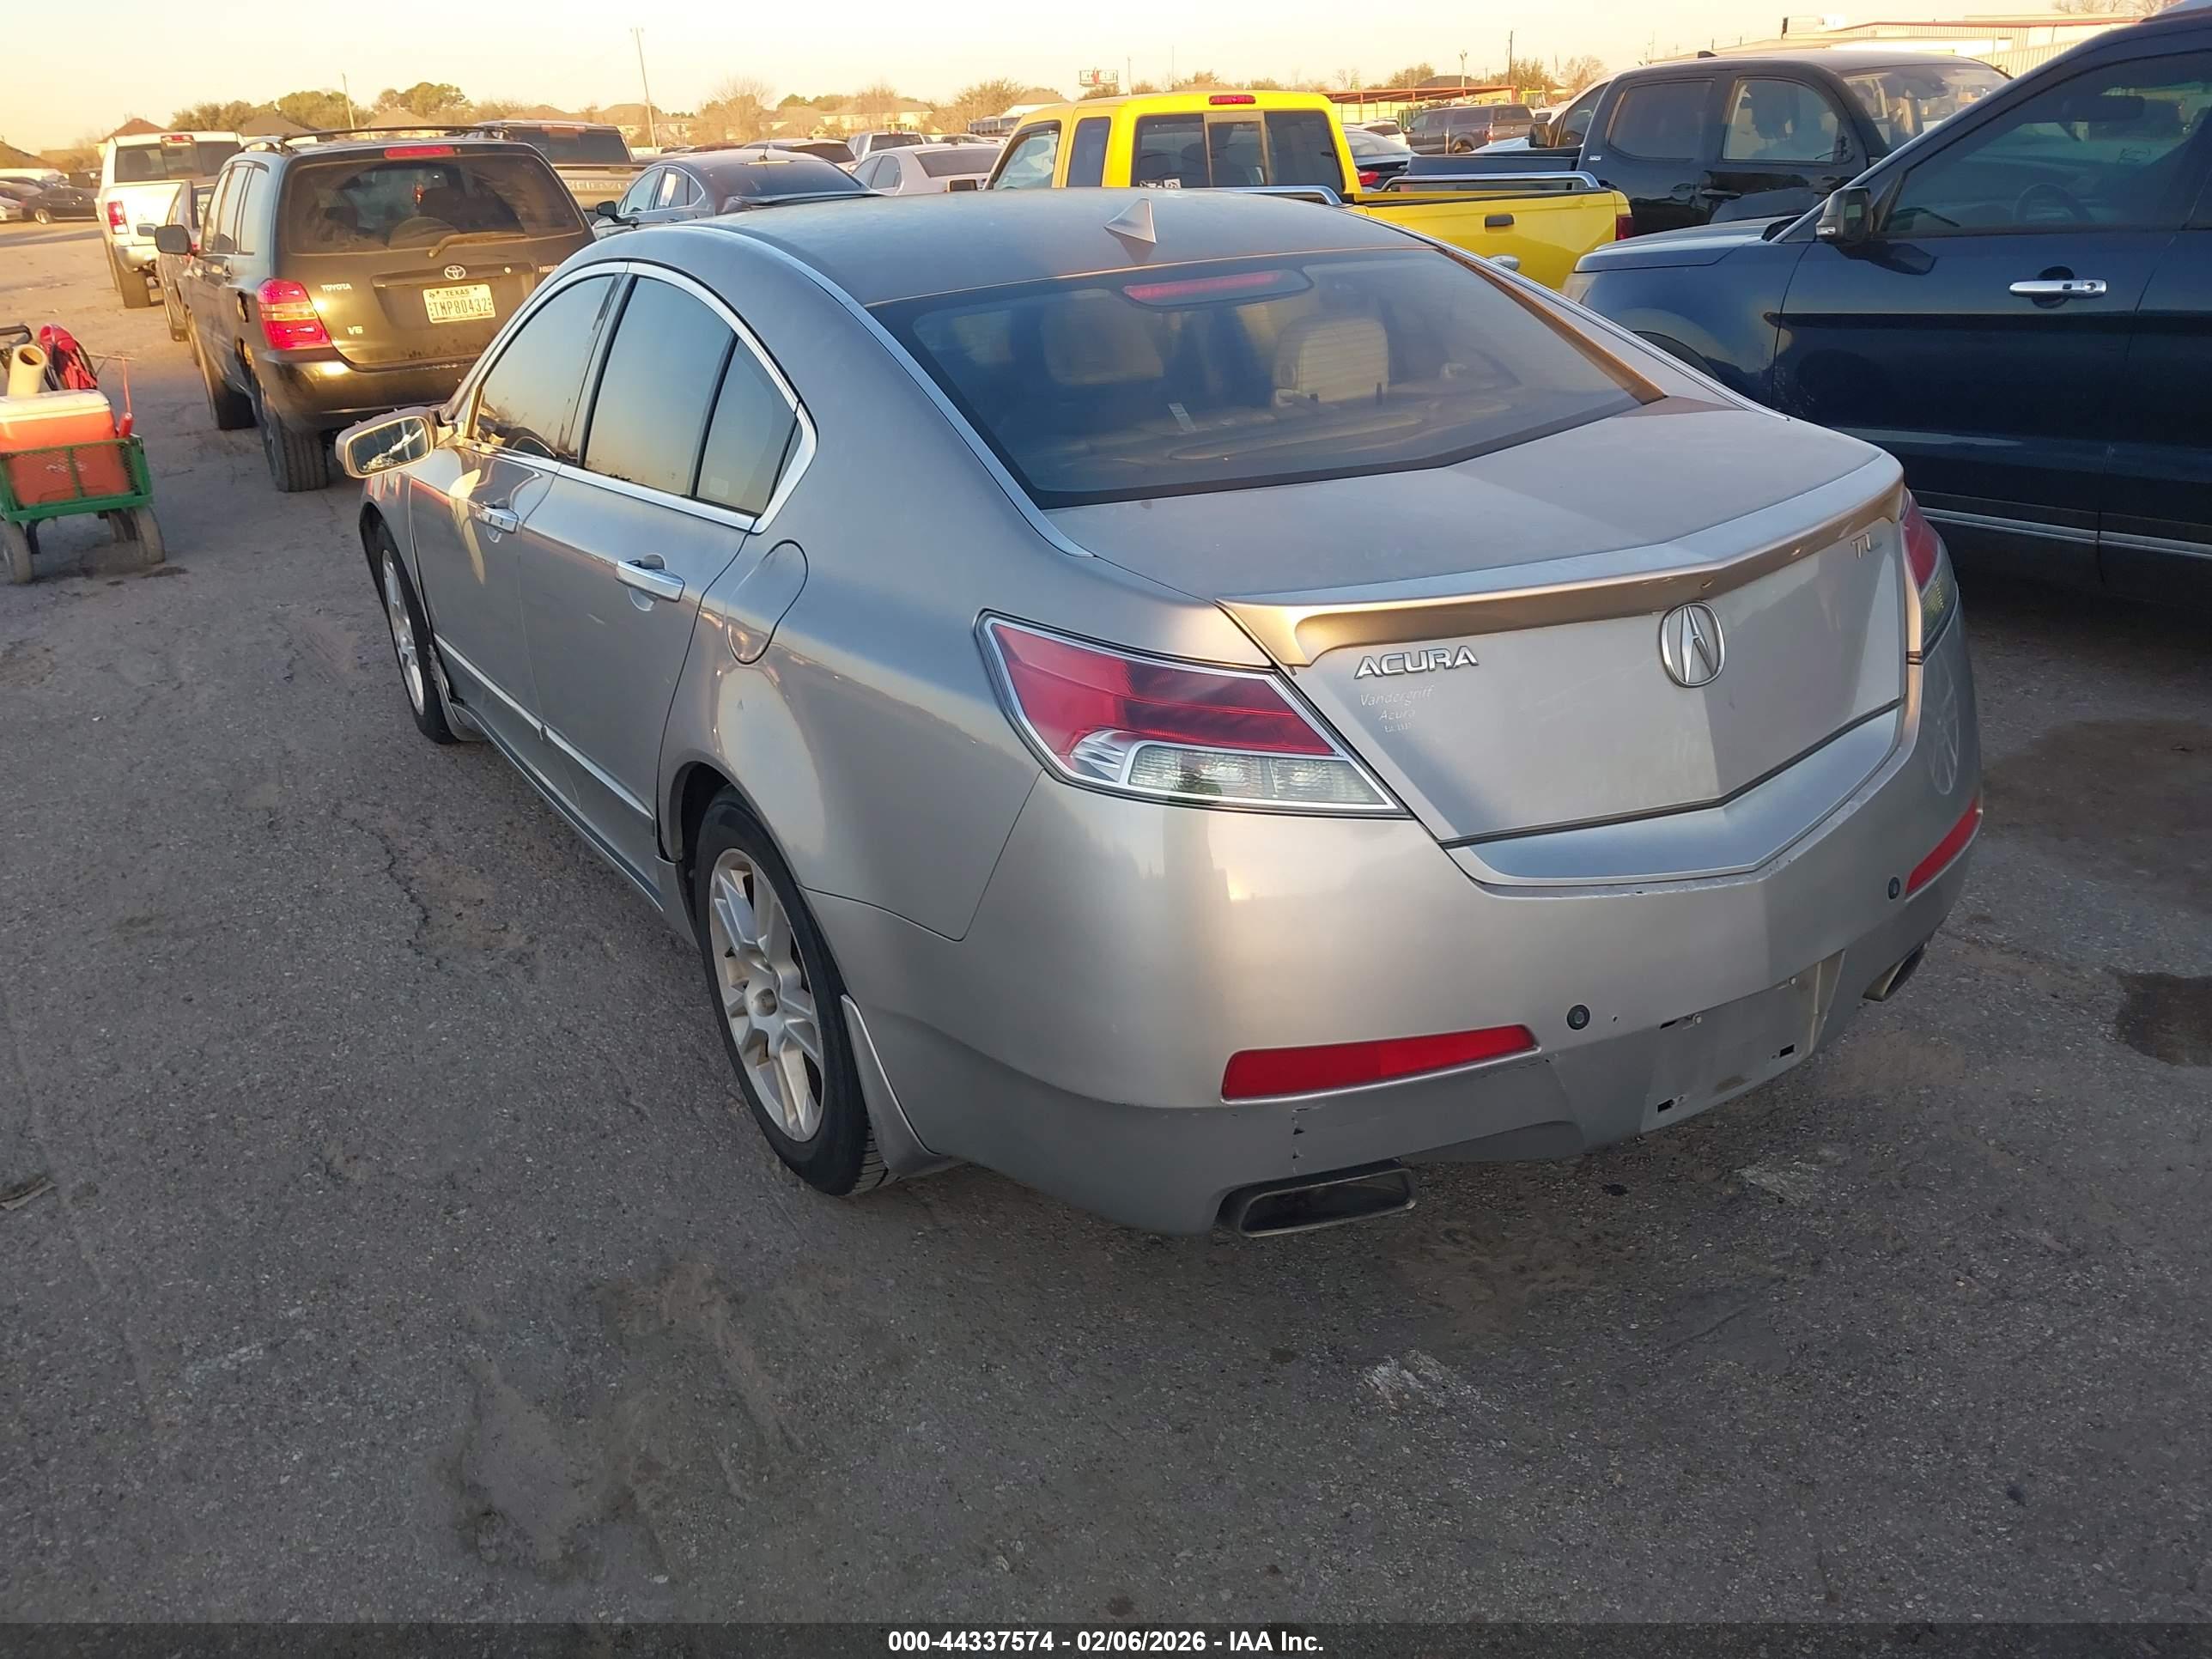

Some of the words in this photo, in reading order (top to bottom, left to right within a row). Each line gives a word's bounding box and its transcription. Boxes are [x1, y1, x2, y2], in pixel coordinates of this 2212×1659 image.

[320, 283, 352, 292] TOYOTA
[445, 288, 470, 297] TEXAS
[347, 326, 364, 336] V6
[1850, 532, 1881, 559] TL
[1355, 646, 1478, 679] ACURA
[1378, 709, 1416, 721] Acura
